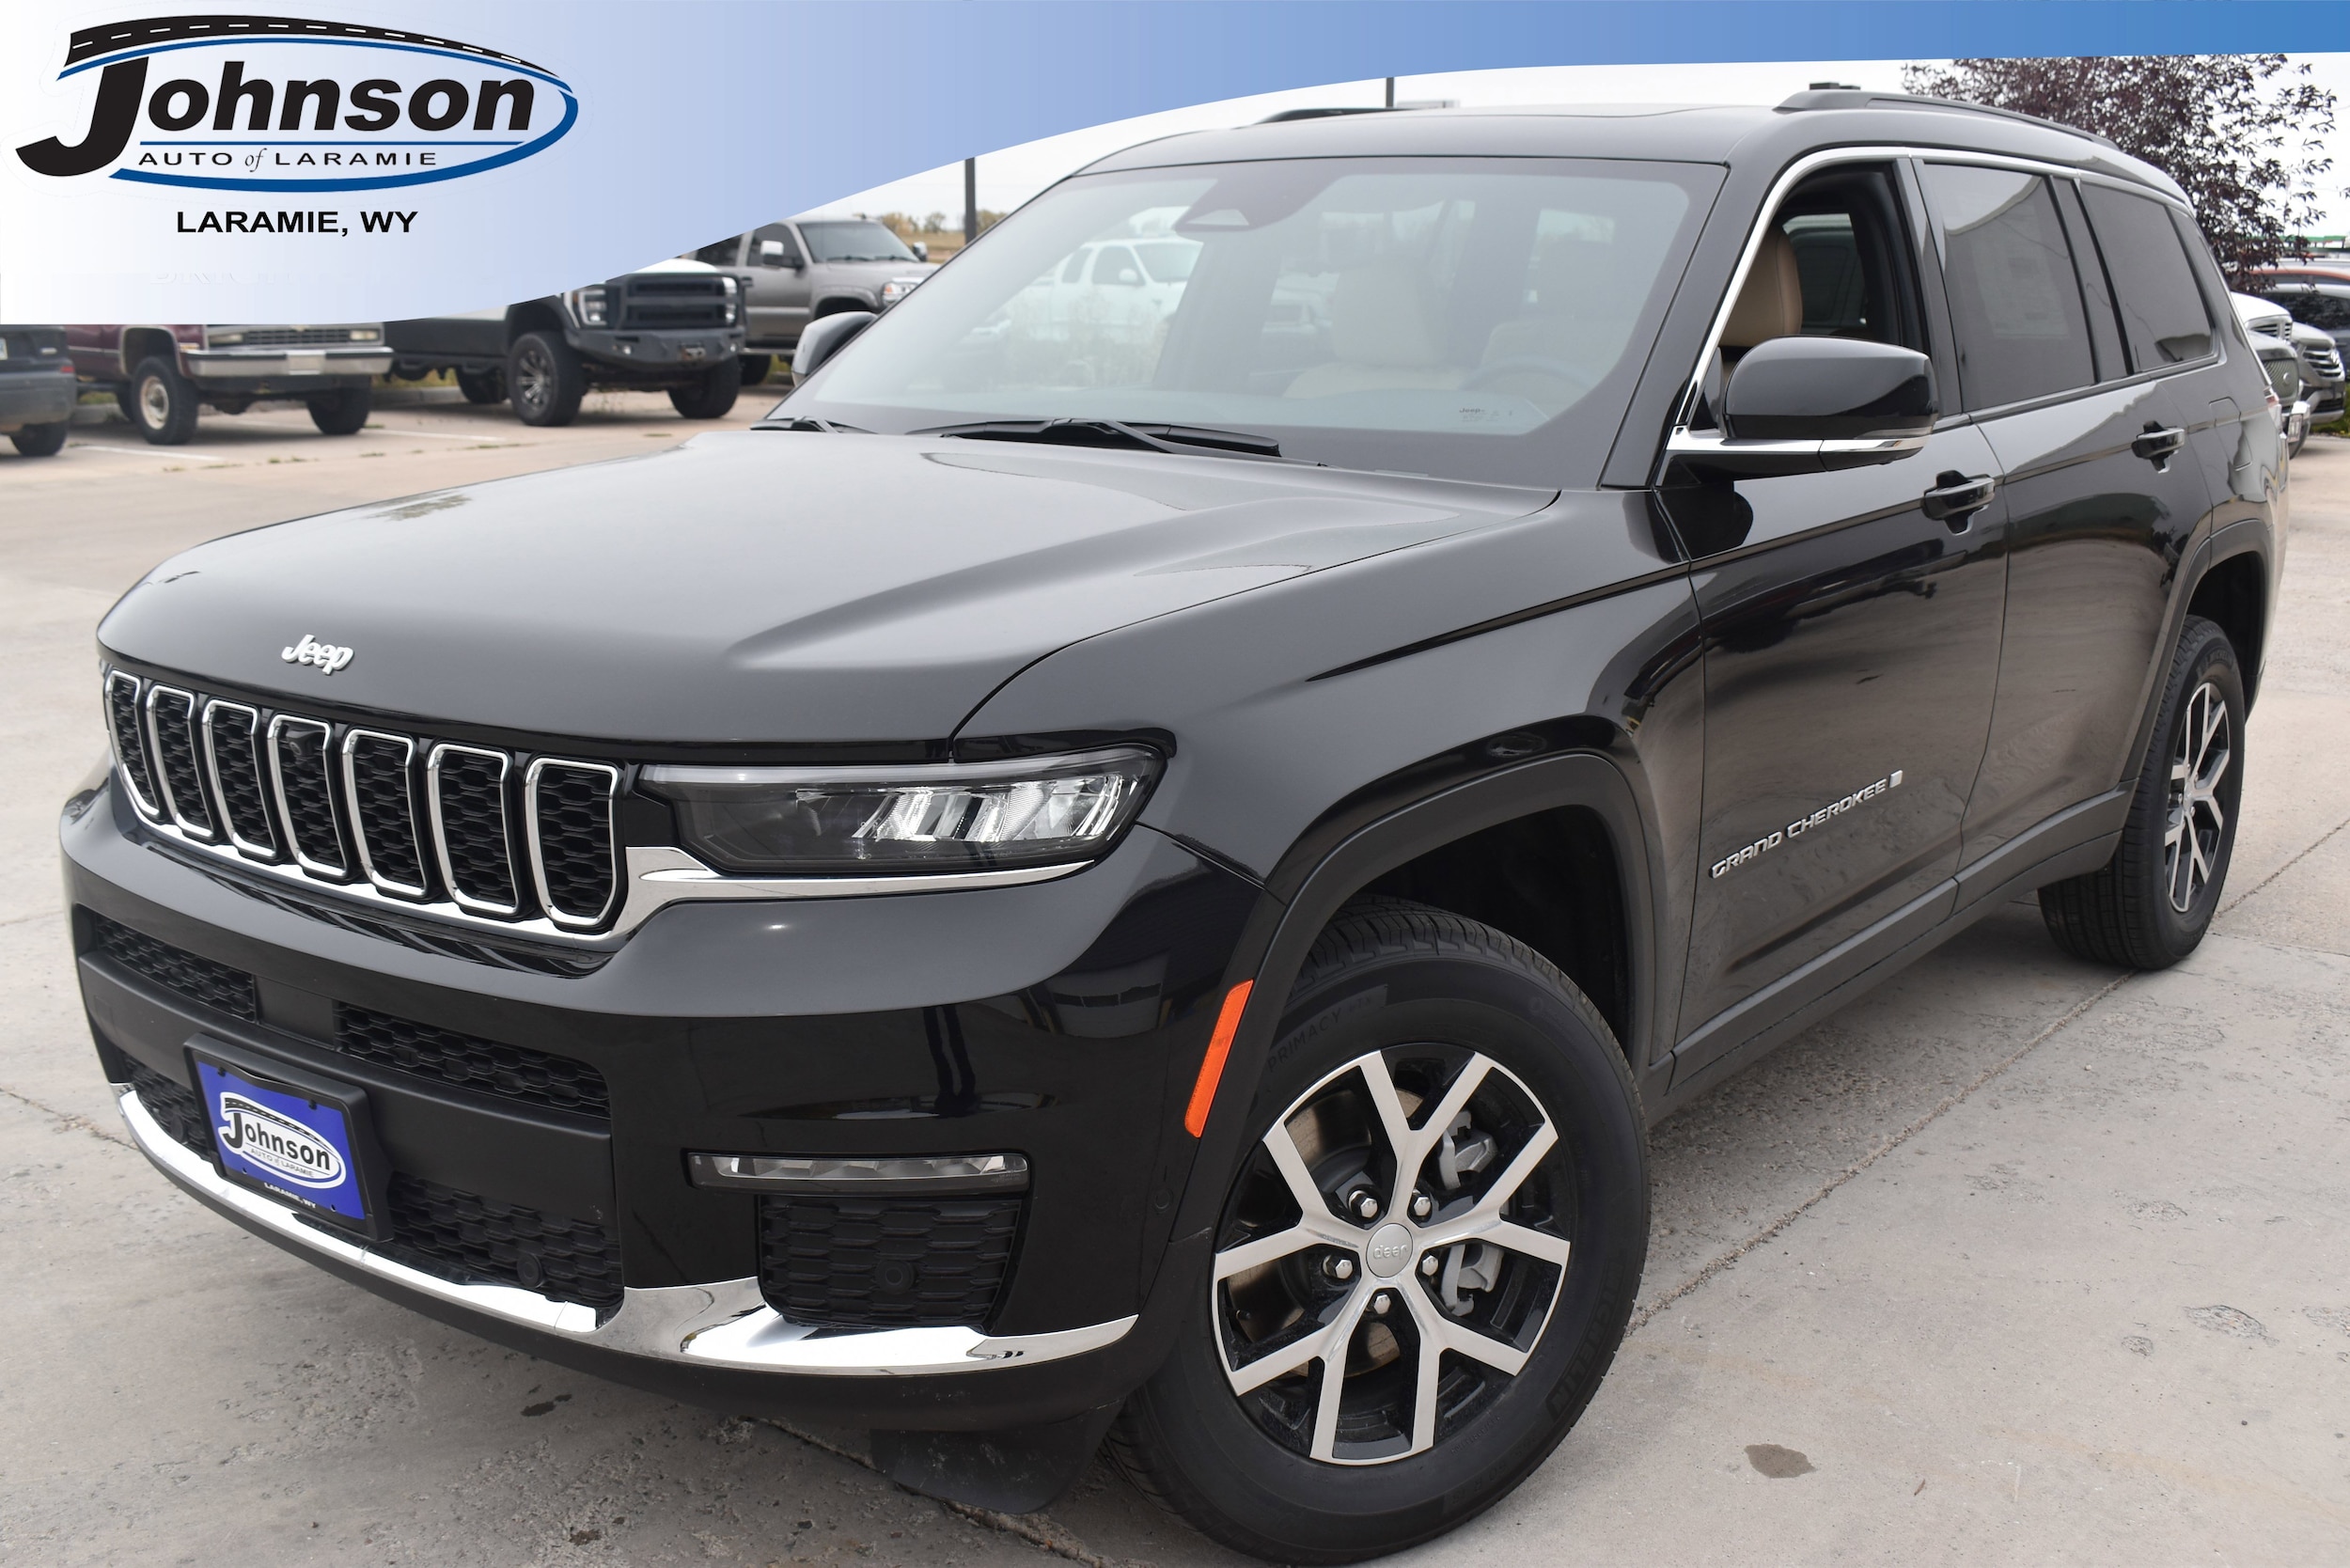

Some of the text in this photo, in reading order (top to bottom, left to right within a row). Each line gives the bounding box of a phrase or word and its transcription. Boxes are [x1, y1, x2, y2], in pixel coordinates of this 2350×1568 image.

[281, 634, 354, 675] Jeep
[1709, 778, 1888, 879] GRAND CHEROKEE
[1266, 1007, 1342, 1074] PRIMACY
[222, 1112, 331, 1171] Johnson
[250, 1148, 274, 1162] AUTO
[1372, 1243, 1409, 1261] Jeep
